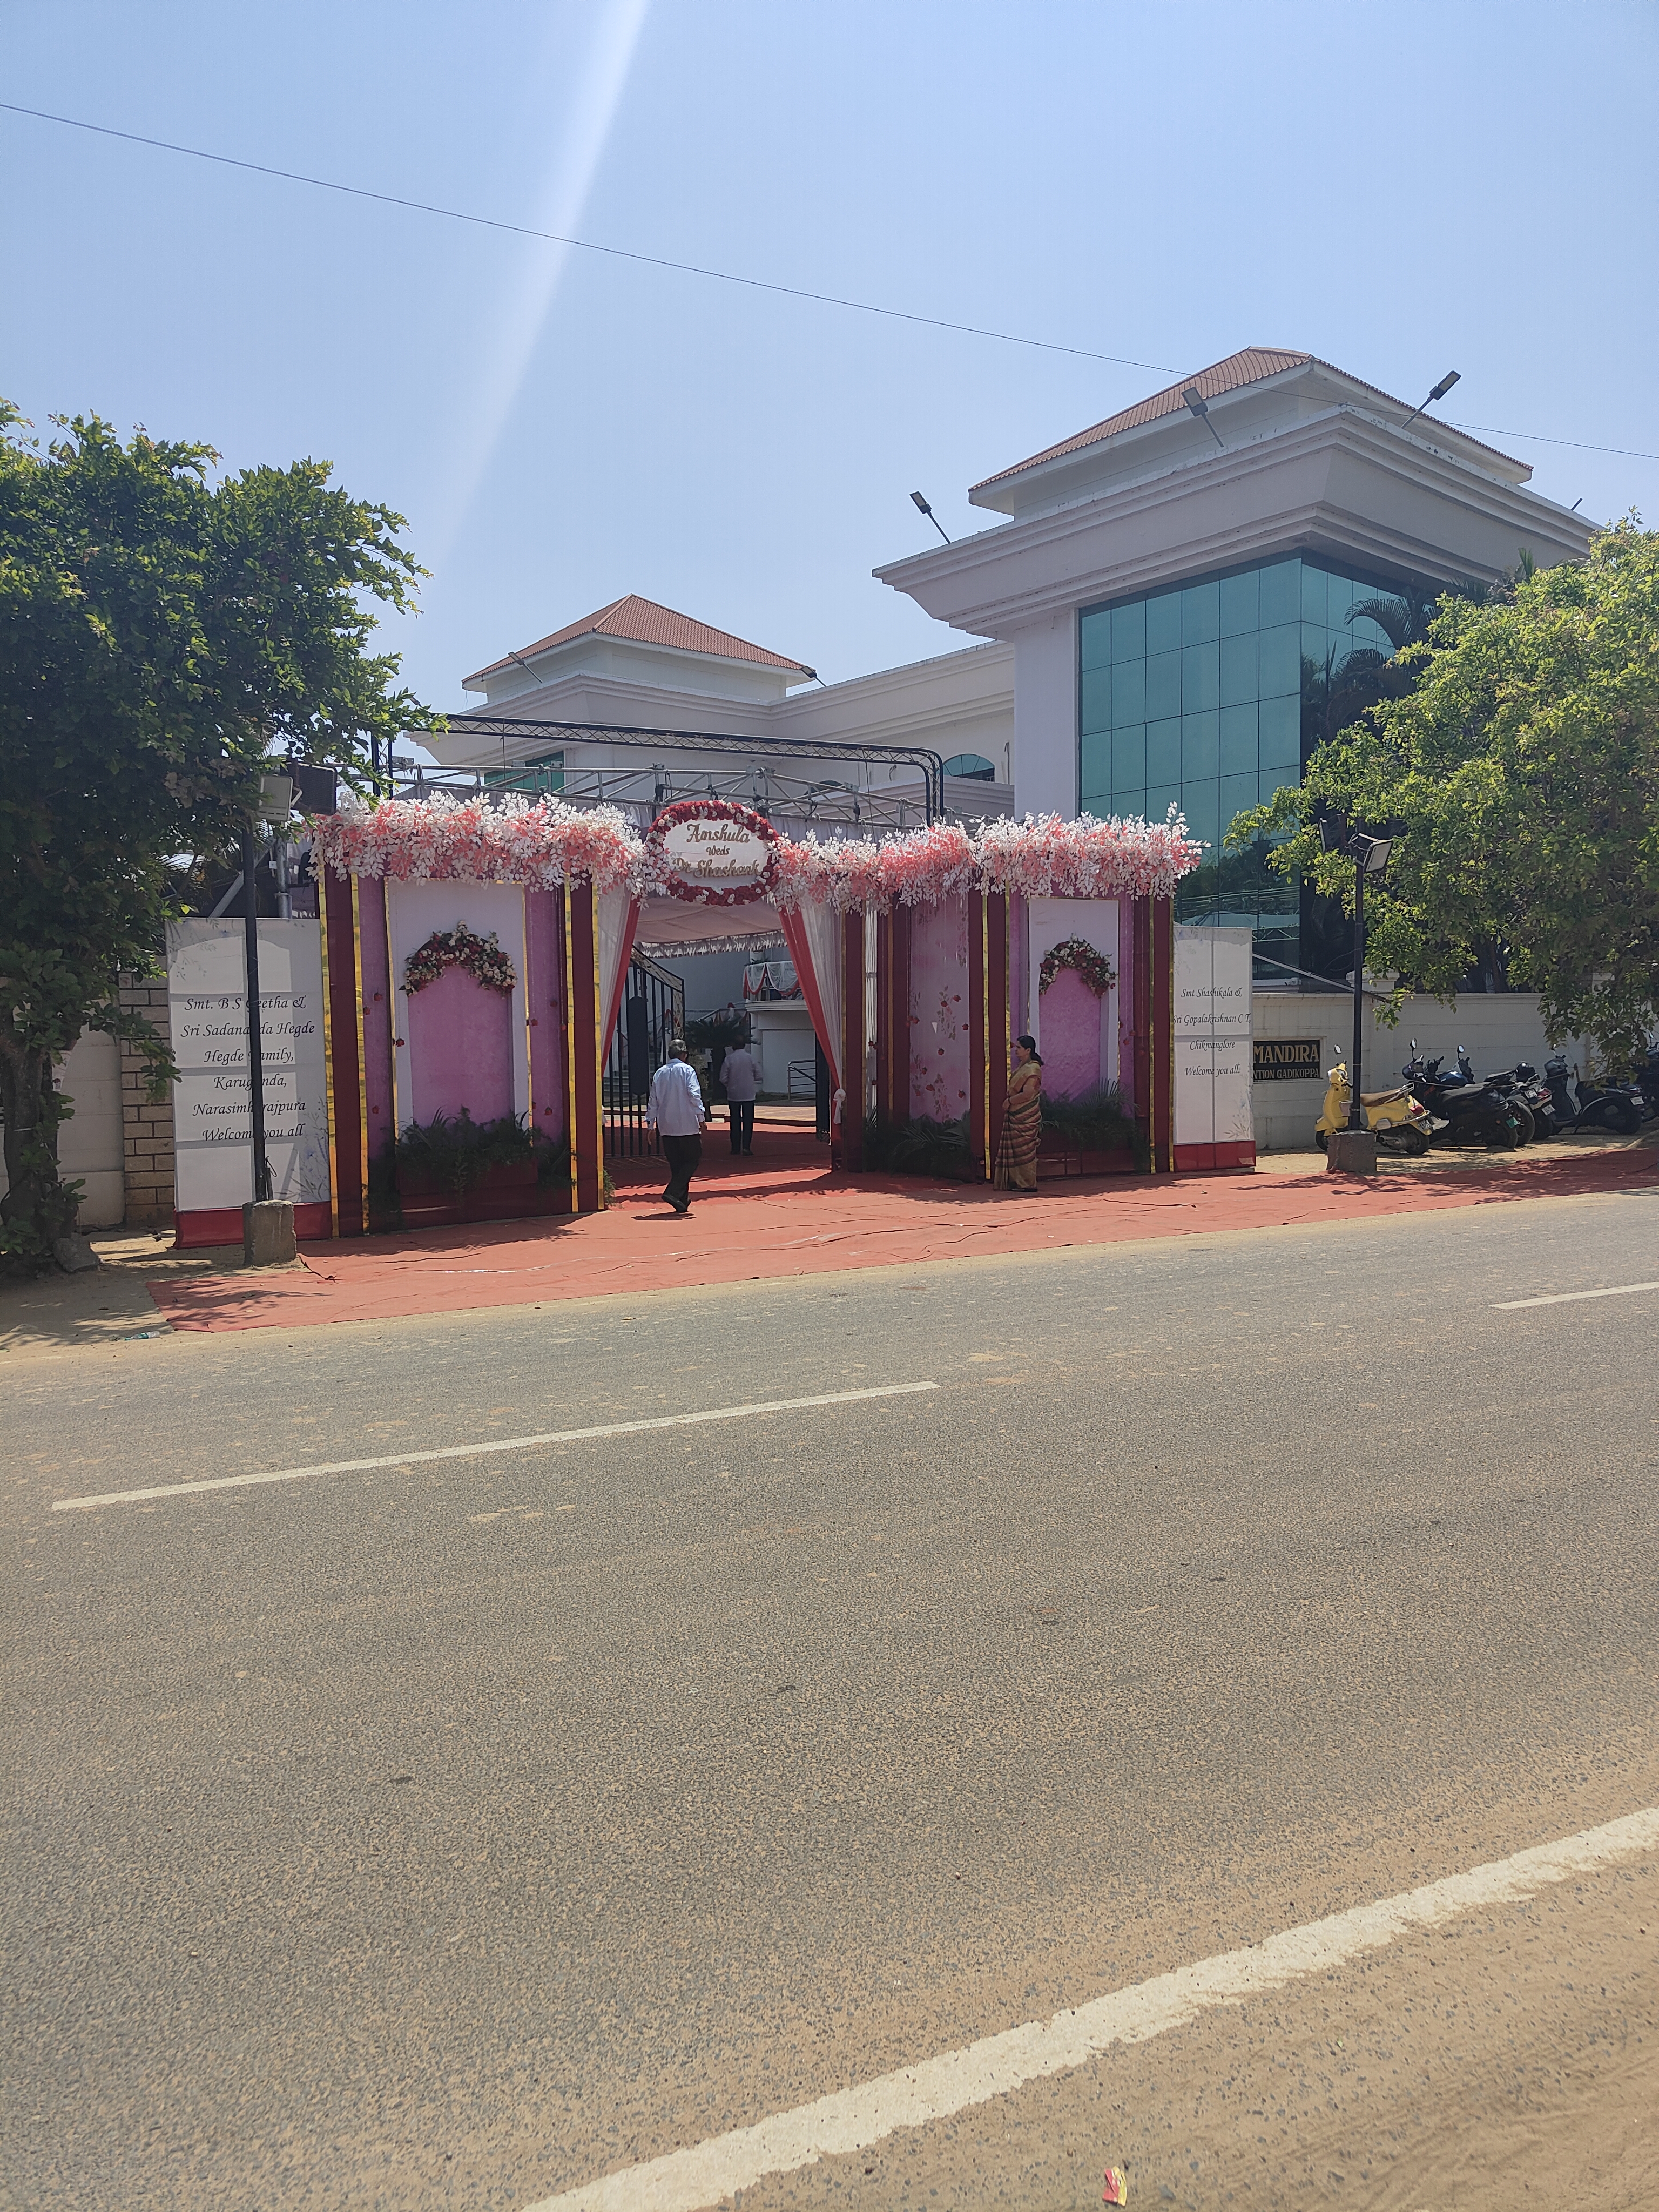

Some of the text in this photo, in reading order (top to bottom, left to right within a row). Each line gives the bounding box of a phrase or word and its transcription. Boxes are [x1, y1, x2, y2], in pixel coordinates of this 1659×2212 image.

[693, 858, 763, 878] Shashank
[1181, 987, 1243, 999] Smt Shashikala &
[184, 995, 306, 1013] Smt. B S eetha &
[1174, 1015, 1182, 1024] Sri
[1184, 1013, 1236, 1026] Gopalakrishnan
[1238, 1014, 1244, 1023] C
[180, 1021, 315, 1037] Sri Sadanada Hegde
[1190, 1039, 1235, 1051] Chikmanglore
[204, 1047, 294, 1066] Hegde amily,
[1253, 1044, 1319, 1063] MANDIRA
[1184, 1065, 1215, 1076] Welcome
[1215, 1068, 1228, 1077] you
[1277, 1068, 1319, 1078] GADIKOPPA
[214, 1074, 287, 1091] Karugnda,
[192, 1100, 306, 1116] Narasimhrajpura
[202, 1123, 306, 1141] Welcom you all
